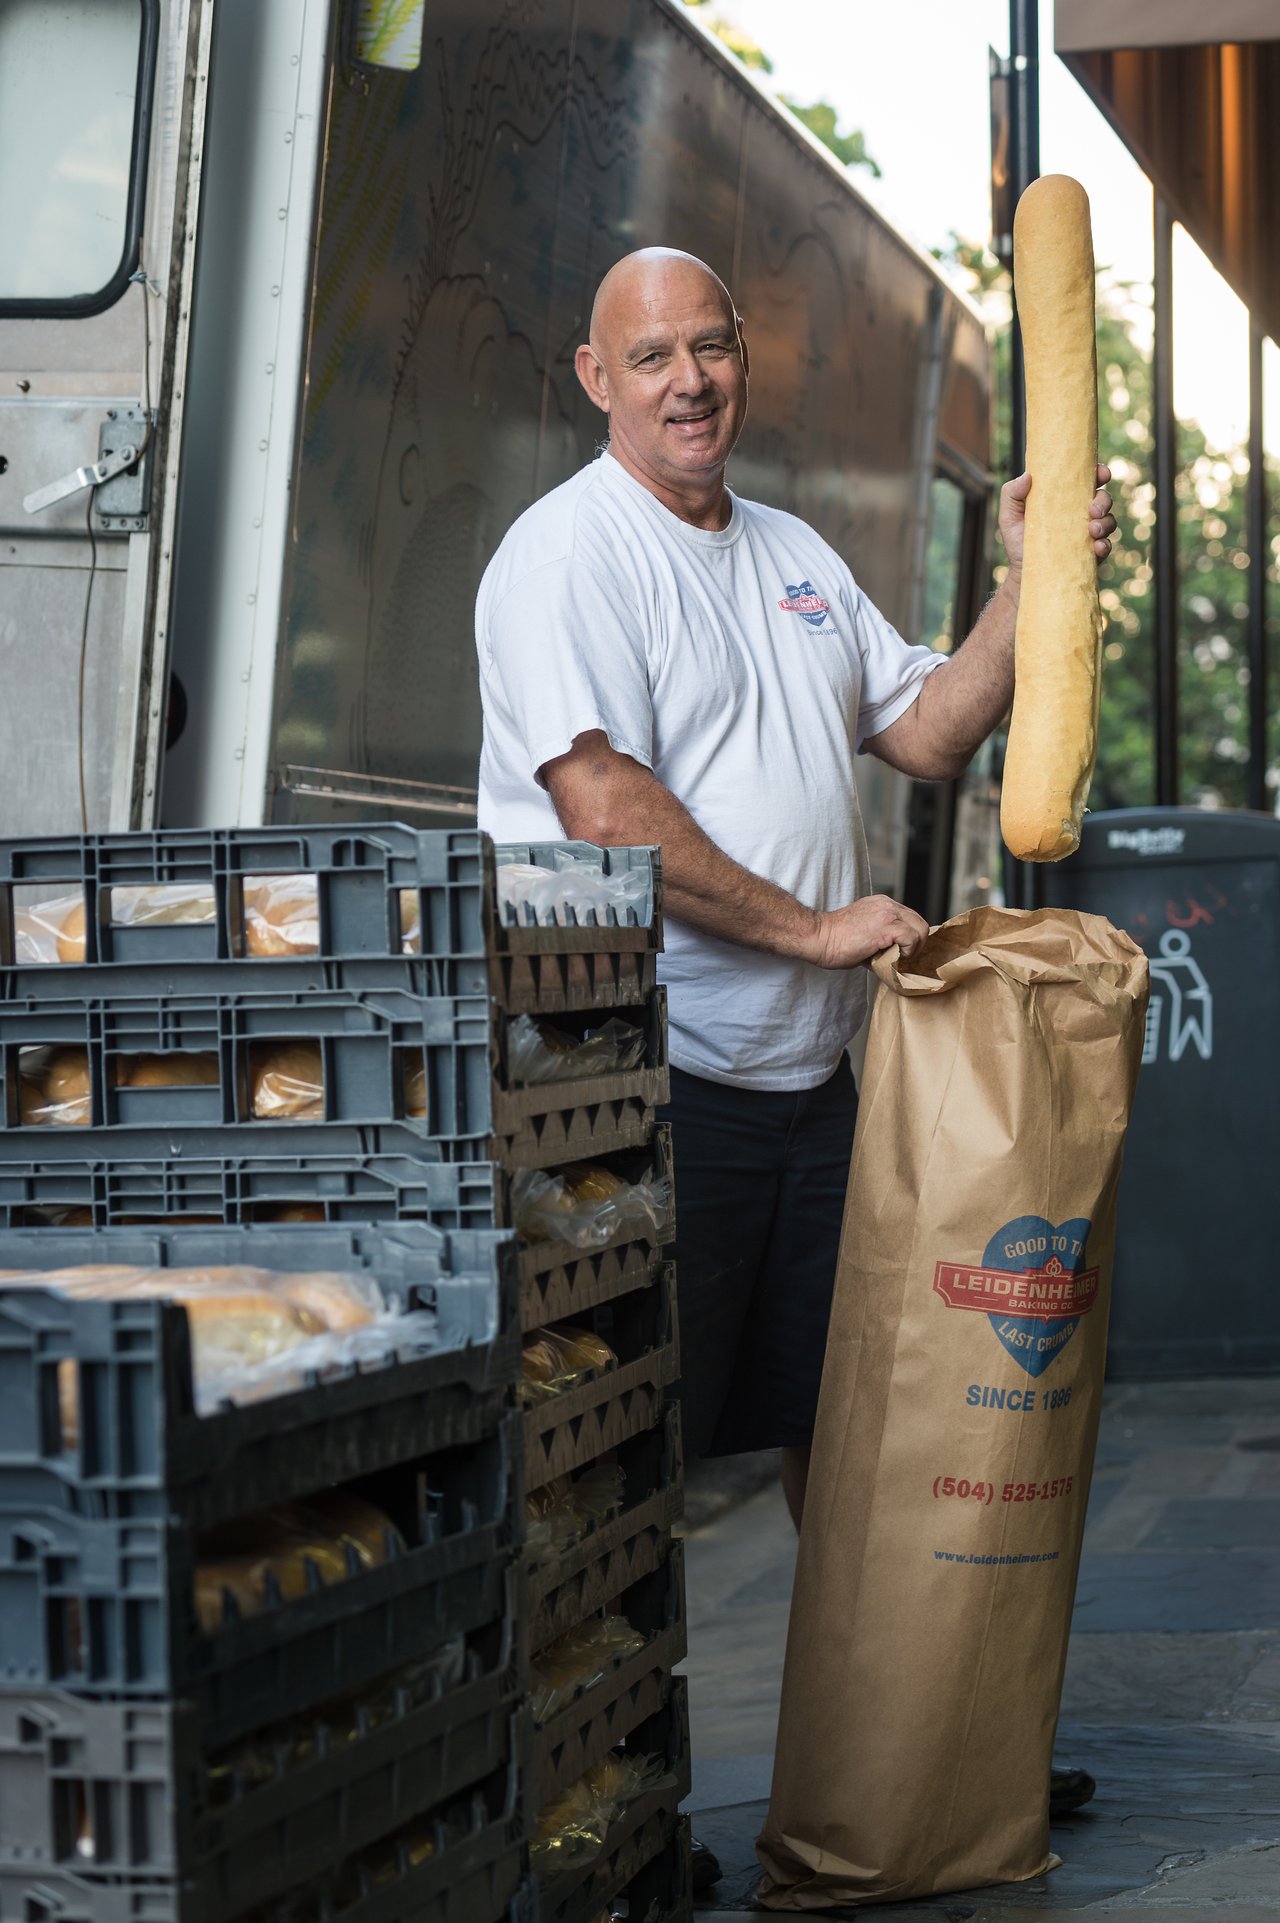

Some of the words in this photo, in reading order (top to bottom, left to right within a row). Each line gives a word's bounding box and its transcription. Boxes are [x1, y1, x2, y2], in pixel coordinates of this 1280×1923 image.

[1004, 1236, 1047, 1259] GOOD
[1051, 1235, 1067, 1251] TO
[953, 1272, 1097, 1300] LEIDENHEIMER
[1008, 1299, 1058, 1311] BAKING
[998, 1320, 1036, 1351] LAST
[1037, 1322, 1074, 1352] CRUMB
[965, 1384, 1037, 1412] SINCE
[1043, 1387, 1073, 1411] 1896
[932, 1476, 995, 1506] (504)
[1002, 1477, 1073, 1502] 525-1575
[934, 1551, 1060, 1565] www.leidenheimer.com
